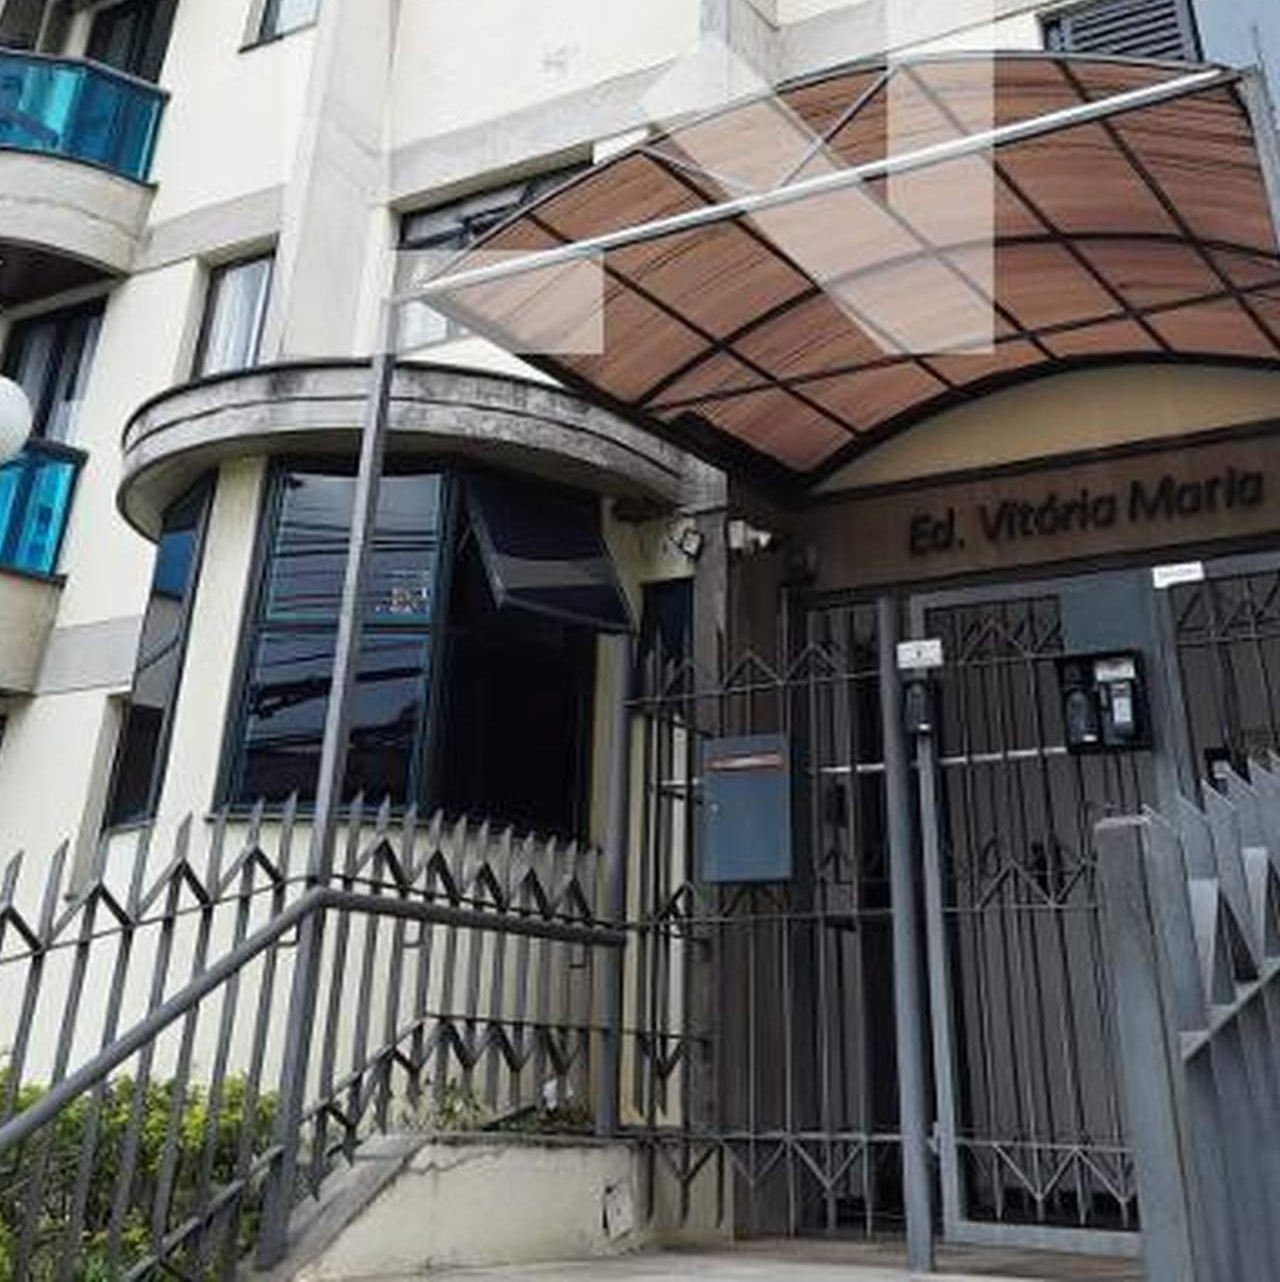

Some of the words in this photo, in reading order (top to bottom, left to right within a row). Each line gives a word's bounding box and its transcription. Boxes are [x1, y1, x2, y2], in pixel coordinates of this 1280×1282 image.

[909, 506, 965, 557] Ed.
[978, 487, 1117, 543] Vitória
[1128, 468, 1264, 522] Maria
